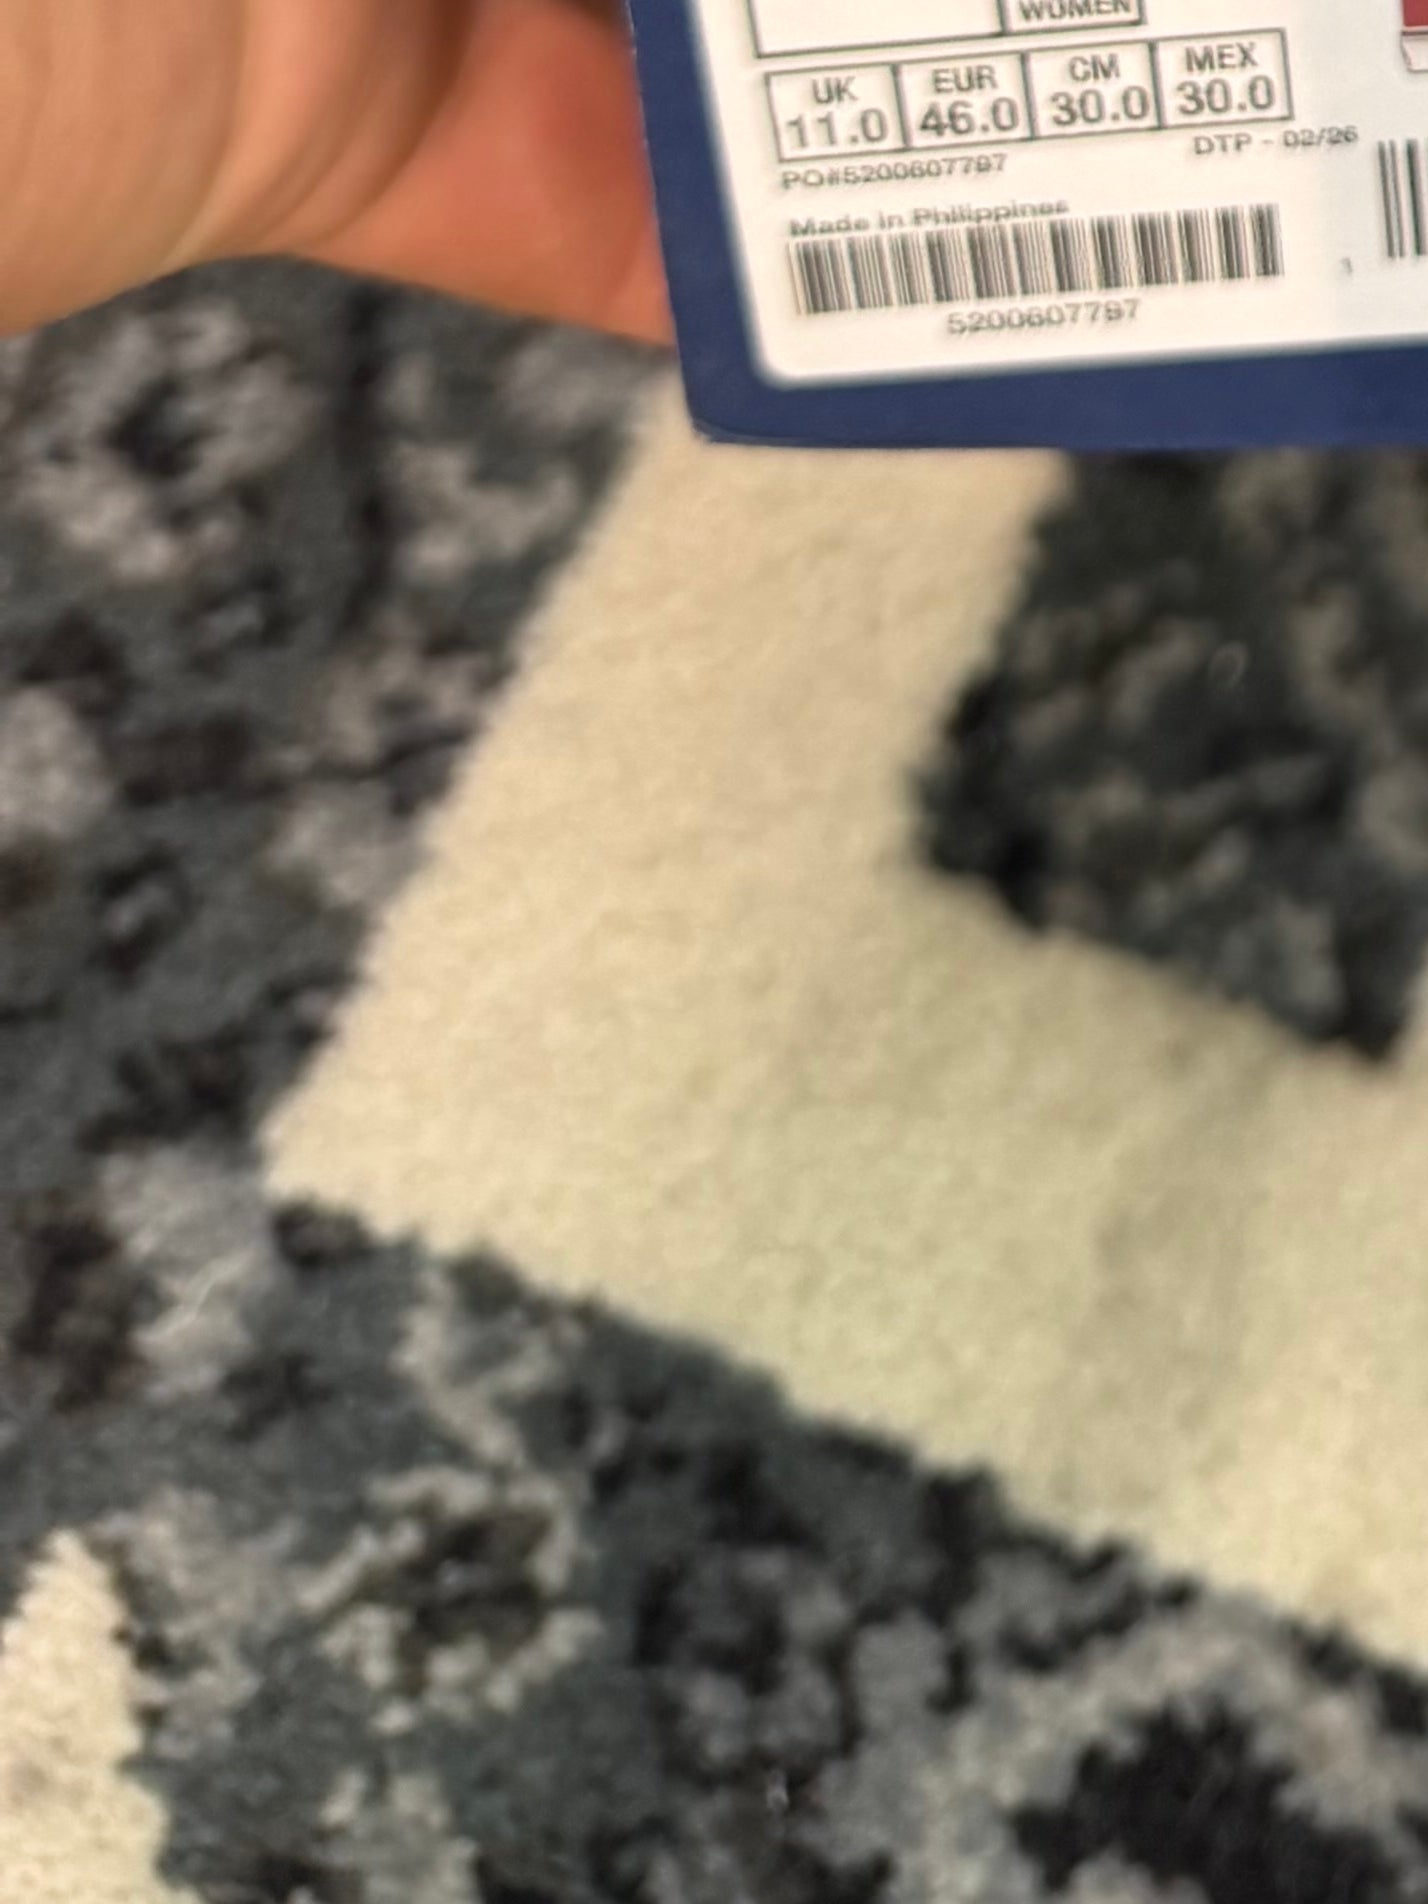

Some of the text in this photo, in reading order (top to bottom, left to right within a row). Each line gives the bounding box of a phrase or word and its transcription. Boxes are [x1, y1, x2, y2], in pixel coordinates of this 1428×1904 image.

[1068, 53, 1121, 82] CM
[1184, 42, 1259, 73] MEX
[811, 76, 859, 104] UK
[931, 64, 998, 93] EUR
[1050, 85, 1150, 126] 30.0
[1176, 75, 1277, 116] 30.0
[785, 108, 887, 149] 11.0
[919, 97, 1019, 136] 46.0
[1193, 132, 1254, 155] DTP
[788, 215, 870, 236] Made
[879, 211, 904, 229] in
